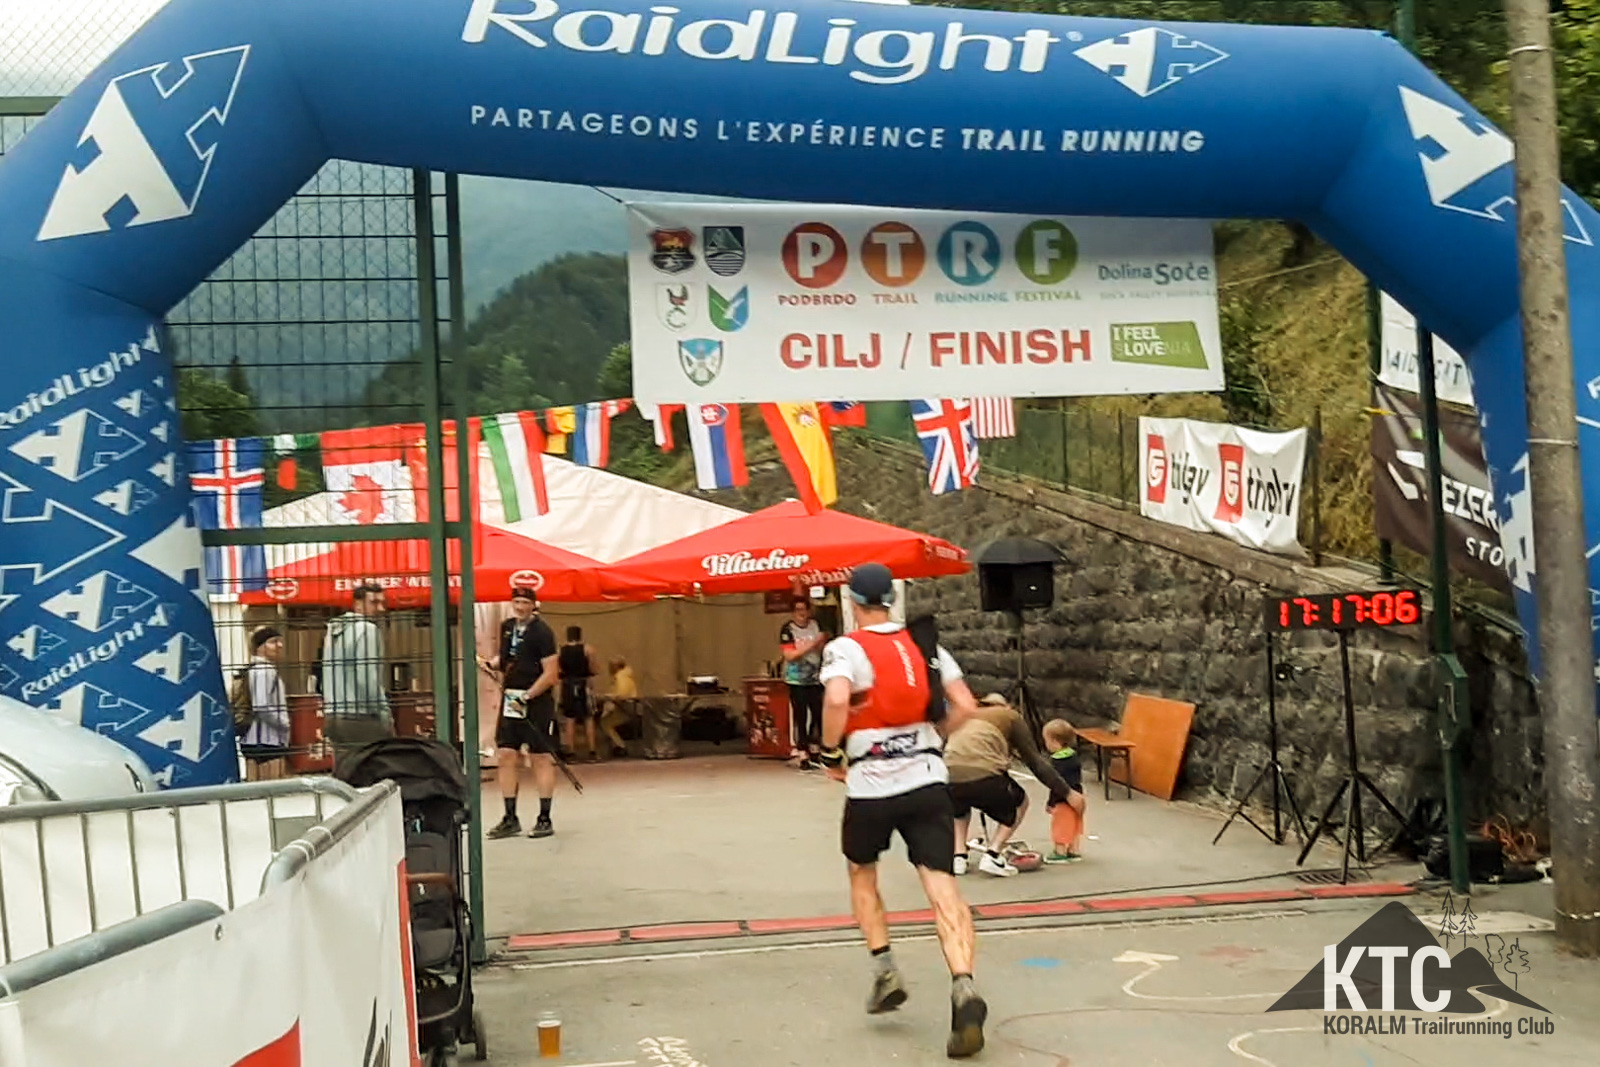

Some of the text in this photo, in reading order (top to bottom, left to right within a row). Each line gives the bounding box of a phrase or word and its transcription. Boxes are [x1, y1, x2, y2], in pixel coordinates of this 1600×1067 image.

[462, 0, 1061, 85] RaidLight
[471, 105, 1205, 153] PARTAGEONS L'EXPÉRIENCE TRAIL RUNNING
[778, 290, 1082, 306] PODBRDO TRAIL RUNNING FESTIVAL
[780, 328, 1092, 371] CILJ / FINISH
[1124, 325, 1160, 341] FEEL
[0, 343, 141, 430] aidLight
[701, 548, 810, 577] Villacher
[1279, 591, 1419, 628] 17:17:06
[22, 621, 145, 701] RaidLight
